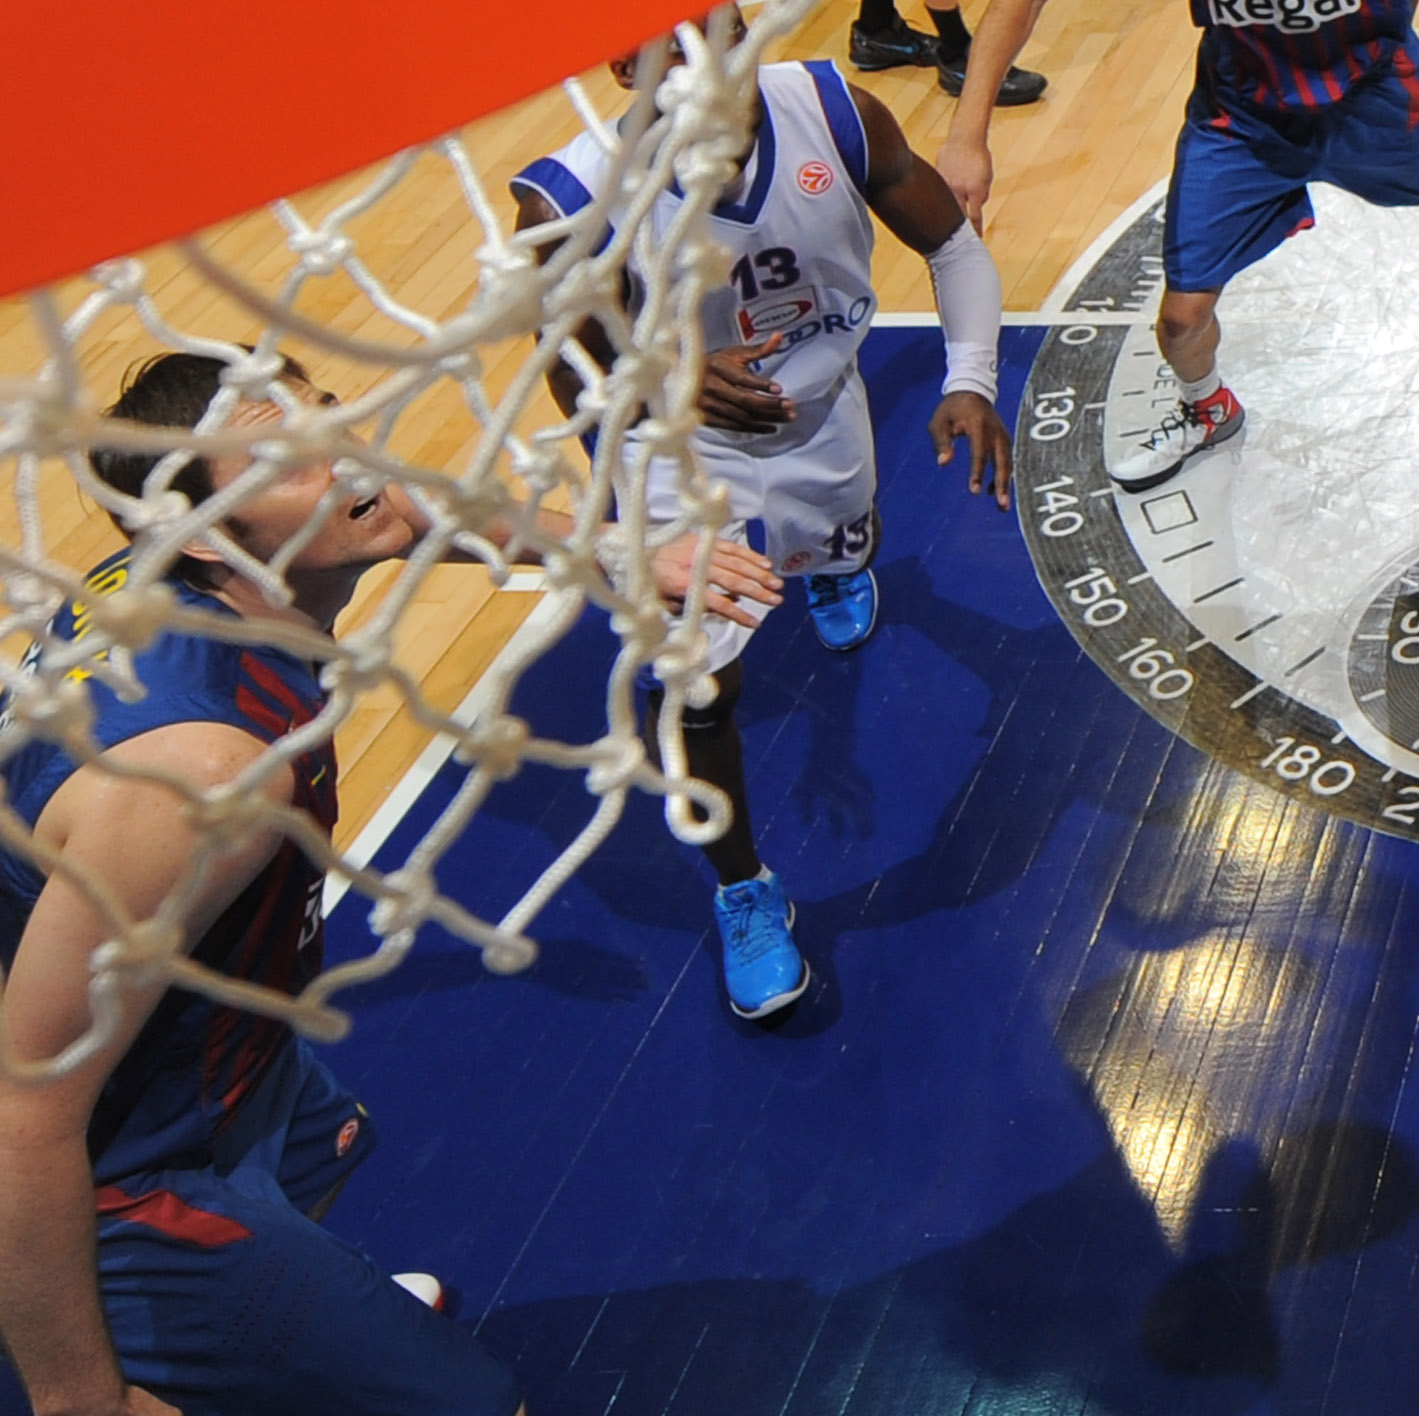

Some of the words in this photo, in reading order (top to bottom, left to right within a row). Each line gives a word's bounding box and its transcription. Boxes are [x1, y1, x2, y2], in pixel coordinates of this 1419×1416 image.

[729, 246, 801, 303] 13
[1029, 385, 1077, 442] 130
[827, 514, 870, 562] 13
[1034, 475, 1085, 539] 140
[1064, 566, 1129, 628] 150
[1117, 636, 1194, 701] 160
[1260, 735, 1357, 797] 180
